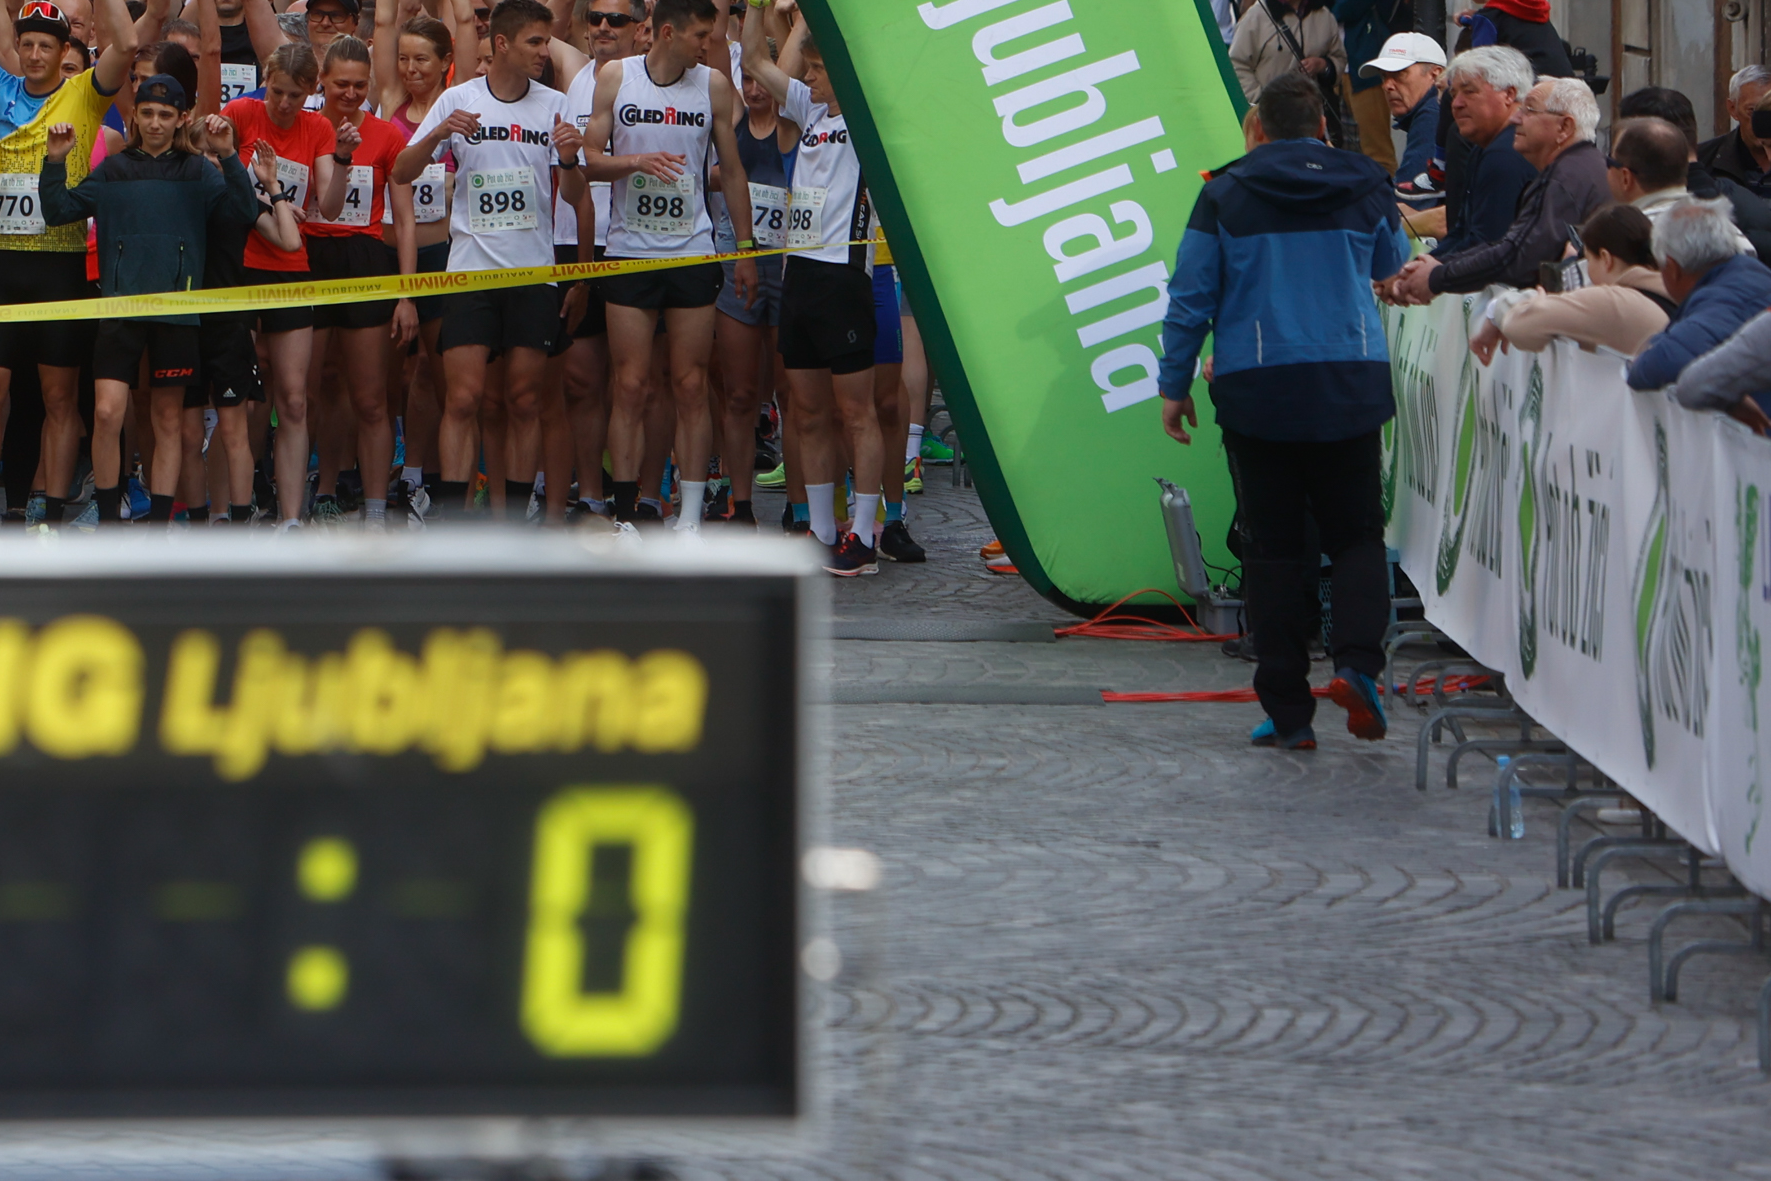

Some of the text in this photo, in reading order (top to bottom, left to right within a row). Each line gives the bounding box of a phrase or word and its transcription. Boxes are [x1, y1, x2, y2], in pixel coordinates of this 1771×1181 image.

[619, 103, 705, 128] GLEDRING
[487, 174, 496, 183] Pot
[496, 173, 504, 182] ob
[479, 190, 526, 215] 898
[637, 194, 684, 218] 898
[754, 205, 784, 230] 78
[154, 368, 194, 379] CCM
[157, 627, 710, 779] Ljubljana
